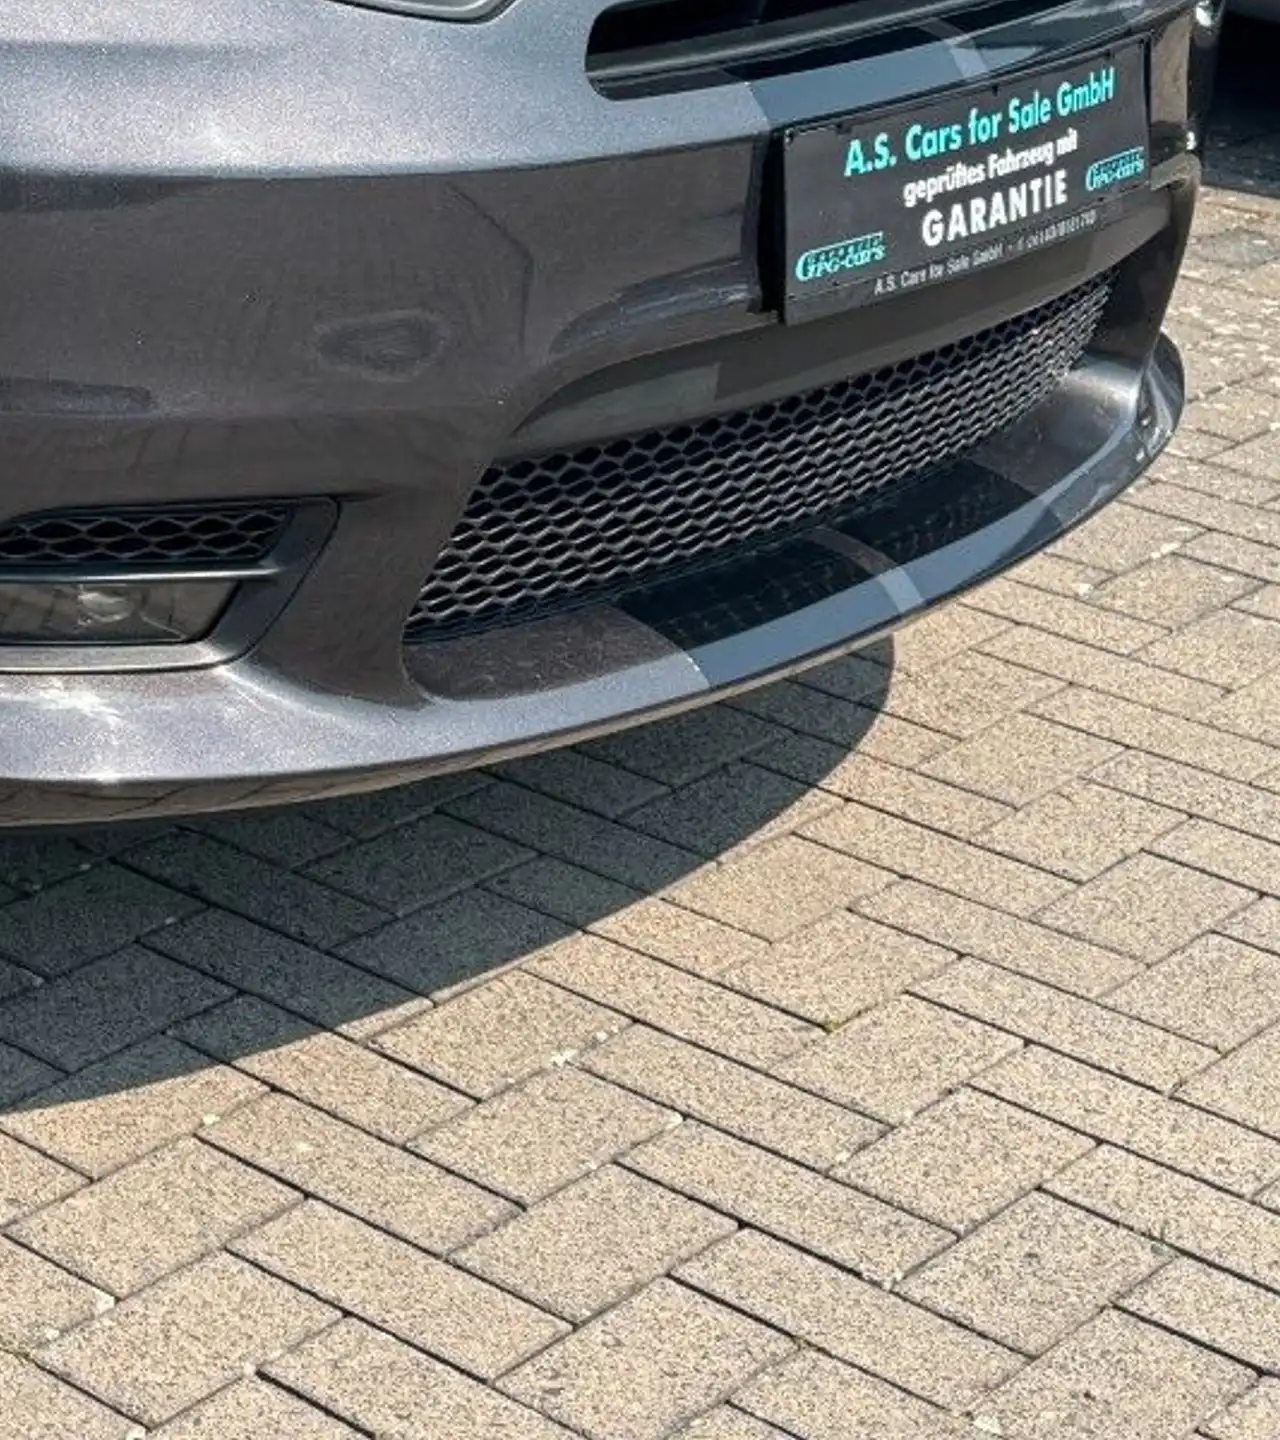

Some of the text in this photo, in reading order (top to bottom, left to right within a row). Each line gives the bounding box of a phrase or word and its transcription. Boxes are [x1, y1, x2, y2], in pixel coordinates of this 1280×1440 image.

[844, 66, 1115, 177] A.S. Cars for Sale GmbH
[902, 160, 986, 208] geprüftes
[987, 137, 1055, 179] Fahrzeug
[1056, 127, 1078, 155] mit
[921, 170, 1068, 247] GARANTIE
